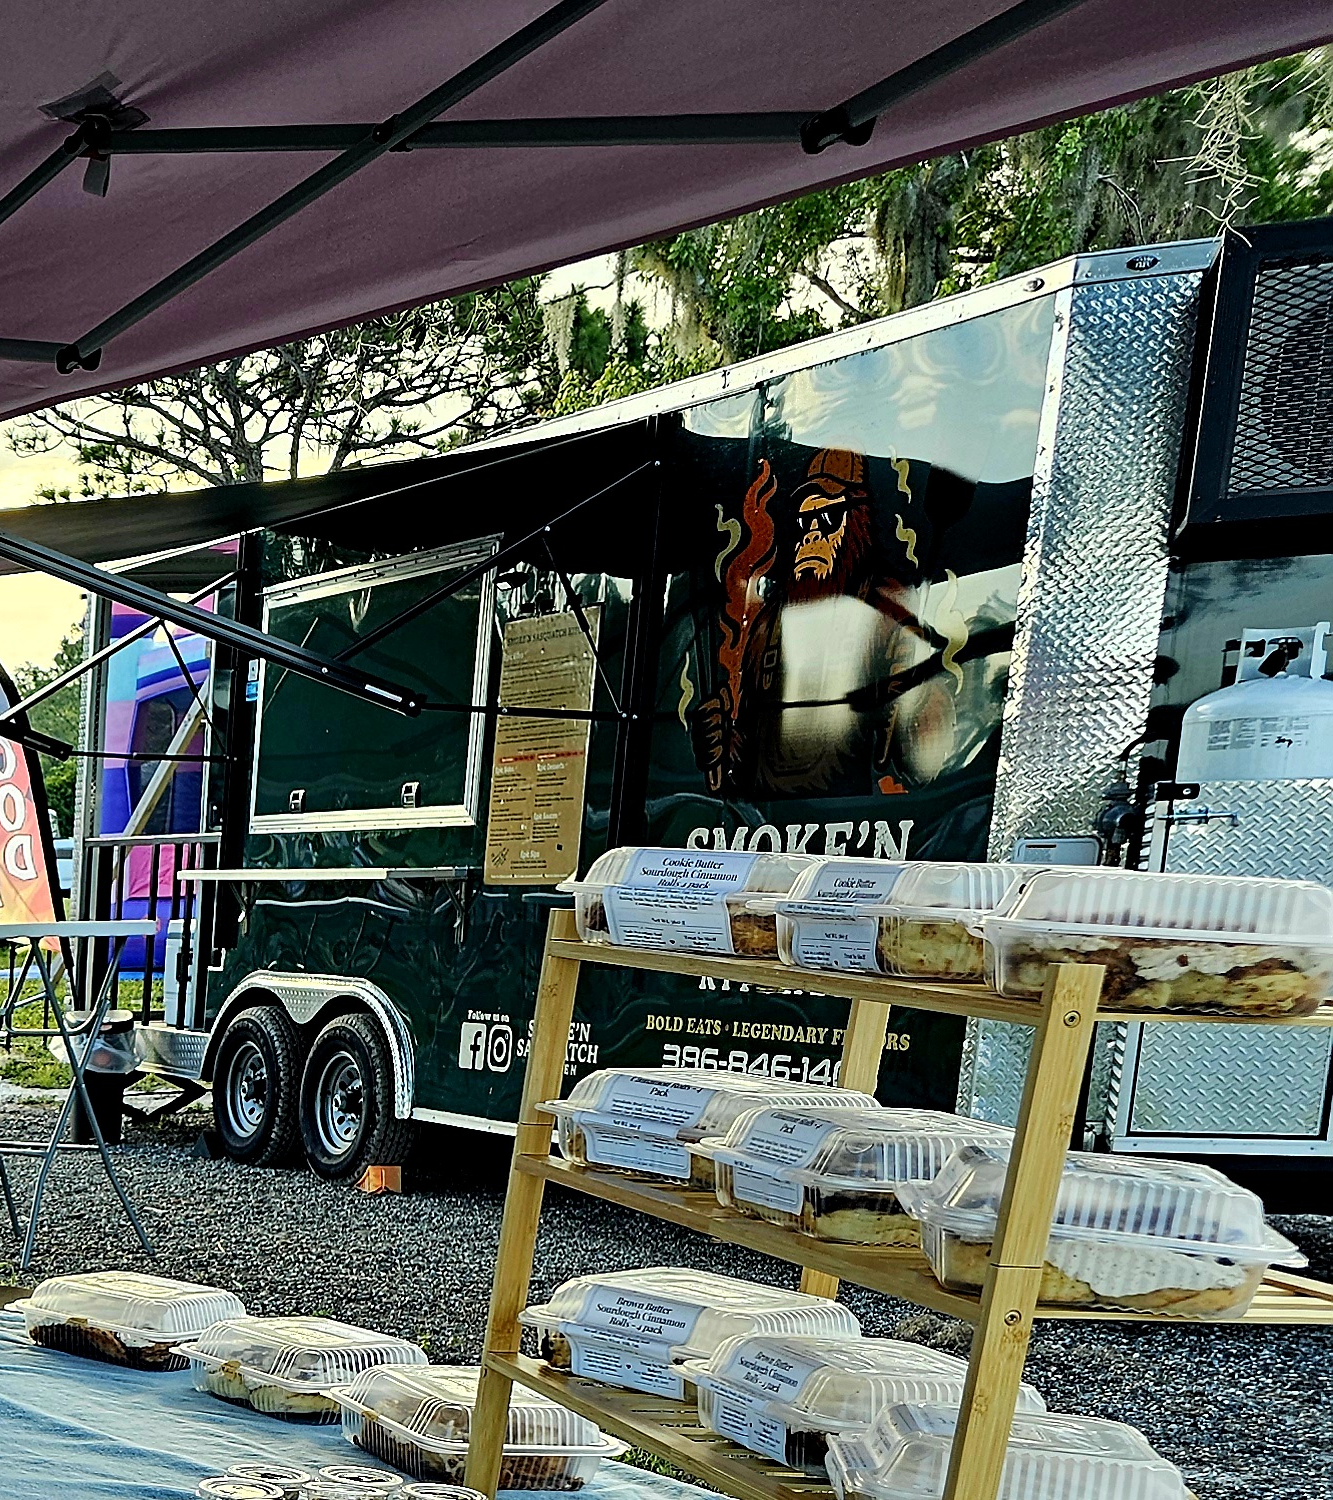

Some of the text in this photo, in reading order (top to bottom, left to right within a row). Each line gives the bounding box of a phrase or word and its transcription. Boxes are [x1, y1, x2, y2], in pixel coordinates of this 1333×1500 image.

[662, 857, 724, 870] Cookie Butter
[640, 867, 738, 881] Sourdough Cinnamon
[646, 1014, 683, 1032] BOLD
[686, 1017, 722, 1035] EATS
[732, 1021, 828, 1045] LEGENDARY
[649, 1087, 670, 1098] Pack
[616, 1297, 673, 1315] Brown Butter
[597, 1303, 686, 1329] Sourdough Cinnamon
[609, 1316, 630, 1328] Rolls
[641, 1325, 664, 1335] pack
